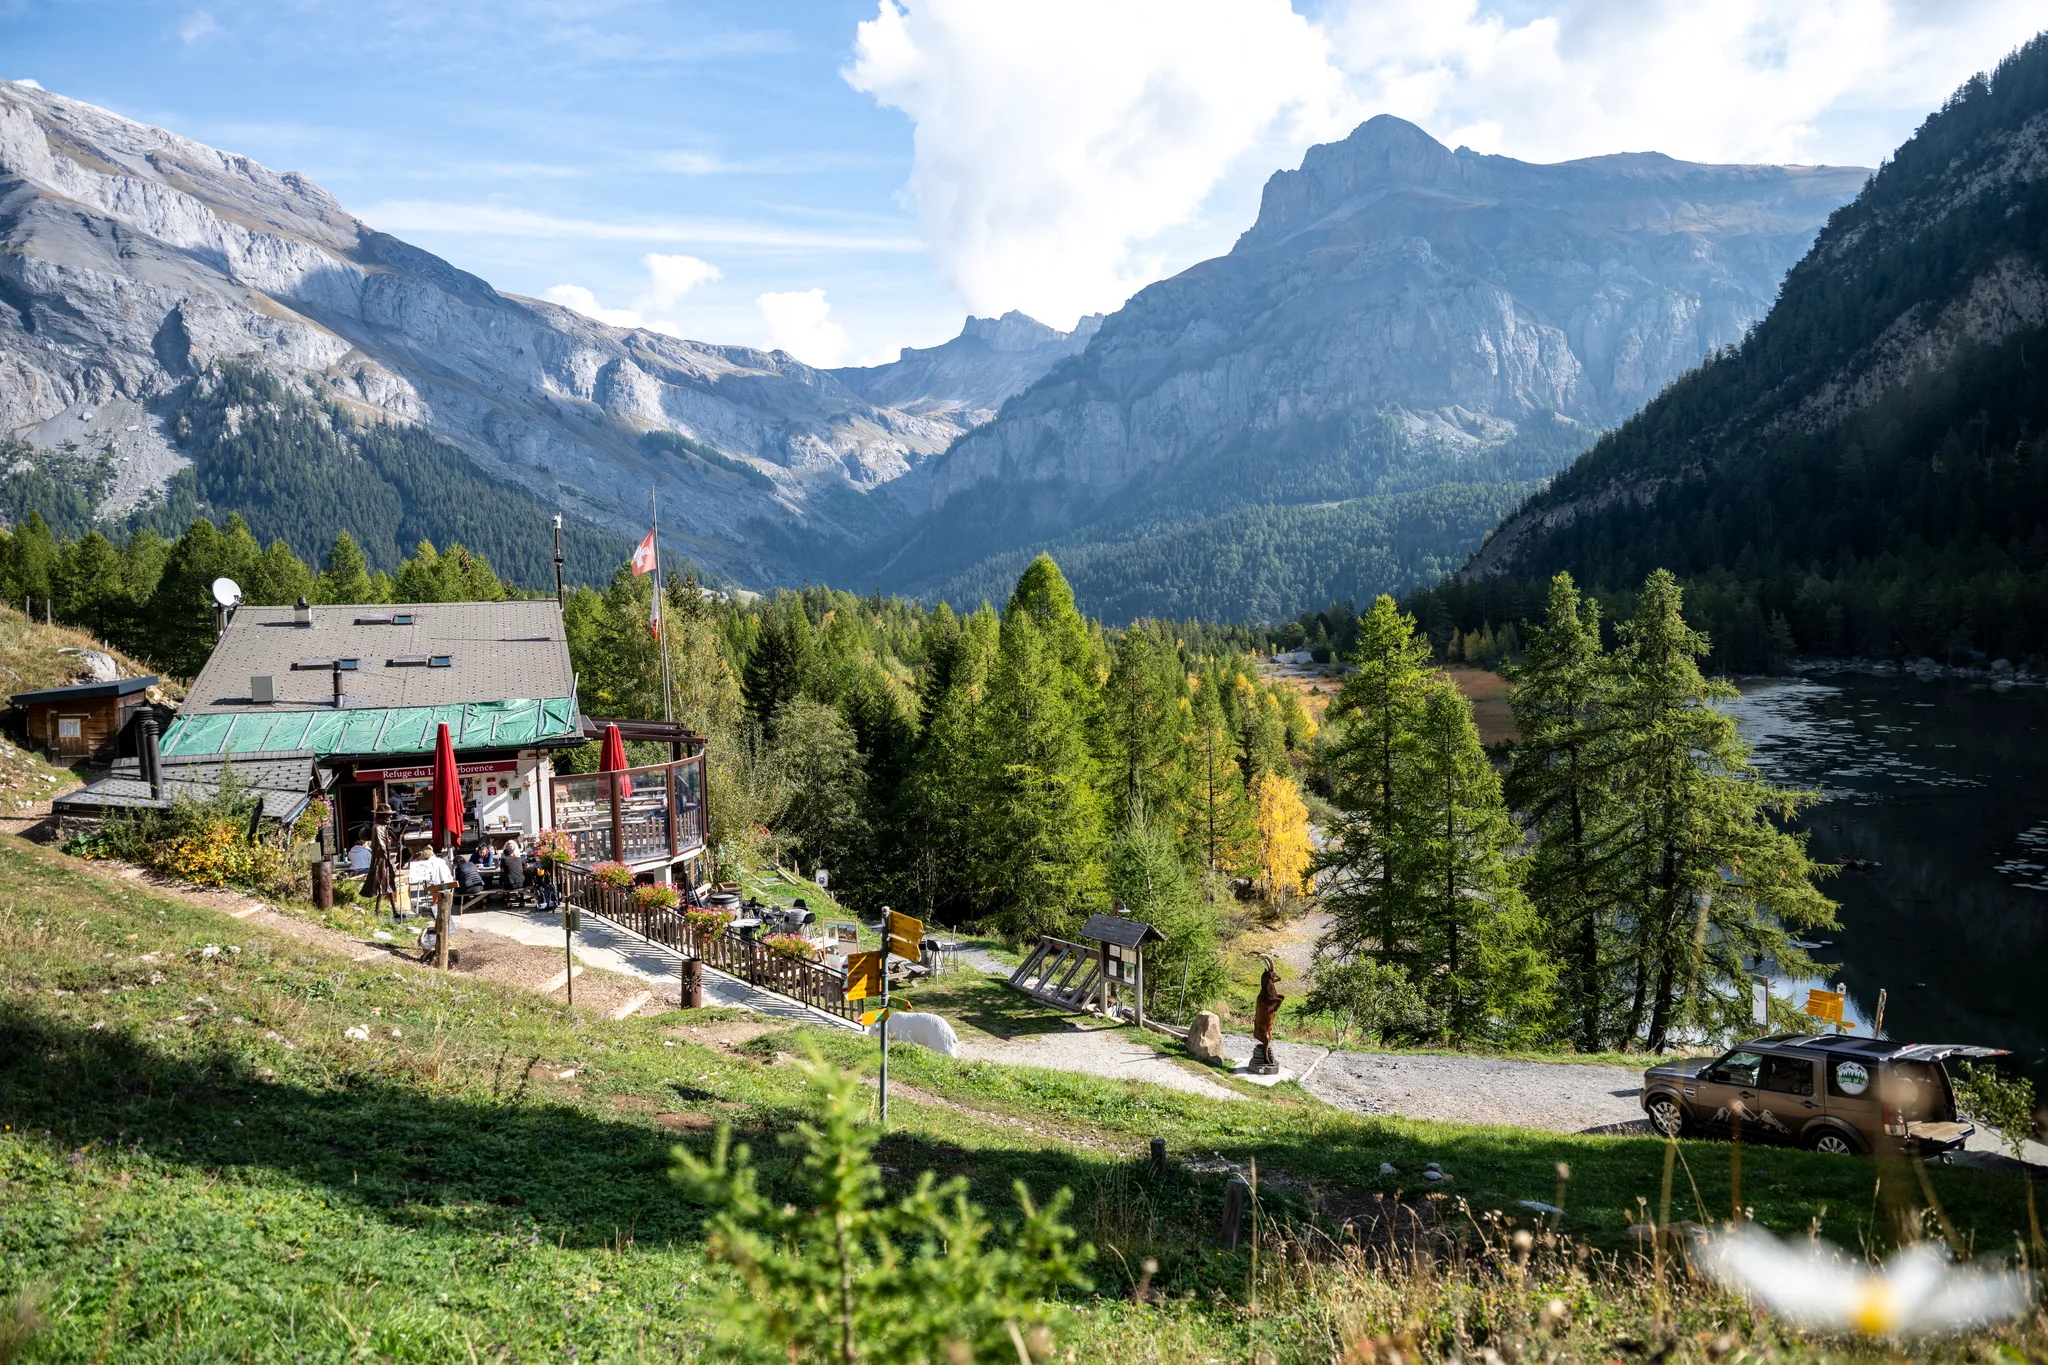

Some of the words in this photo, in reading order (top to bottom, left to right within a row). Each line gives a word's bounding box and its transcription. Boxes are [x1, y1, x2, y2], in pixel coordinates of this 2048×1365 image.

[383, 769, 412, 779] Refuge
[414, 768, 425, 776] du
[457, 765, 494, 774] rborence
